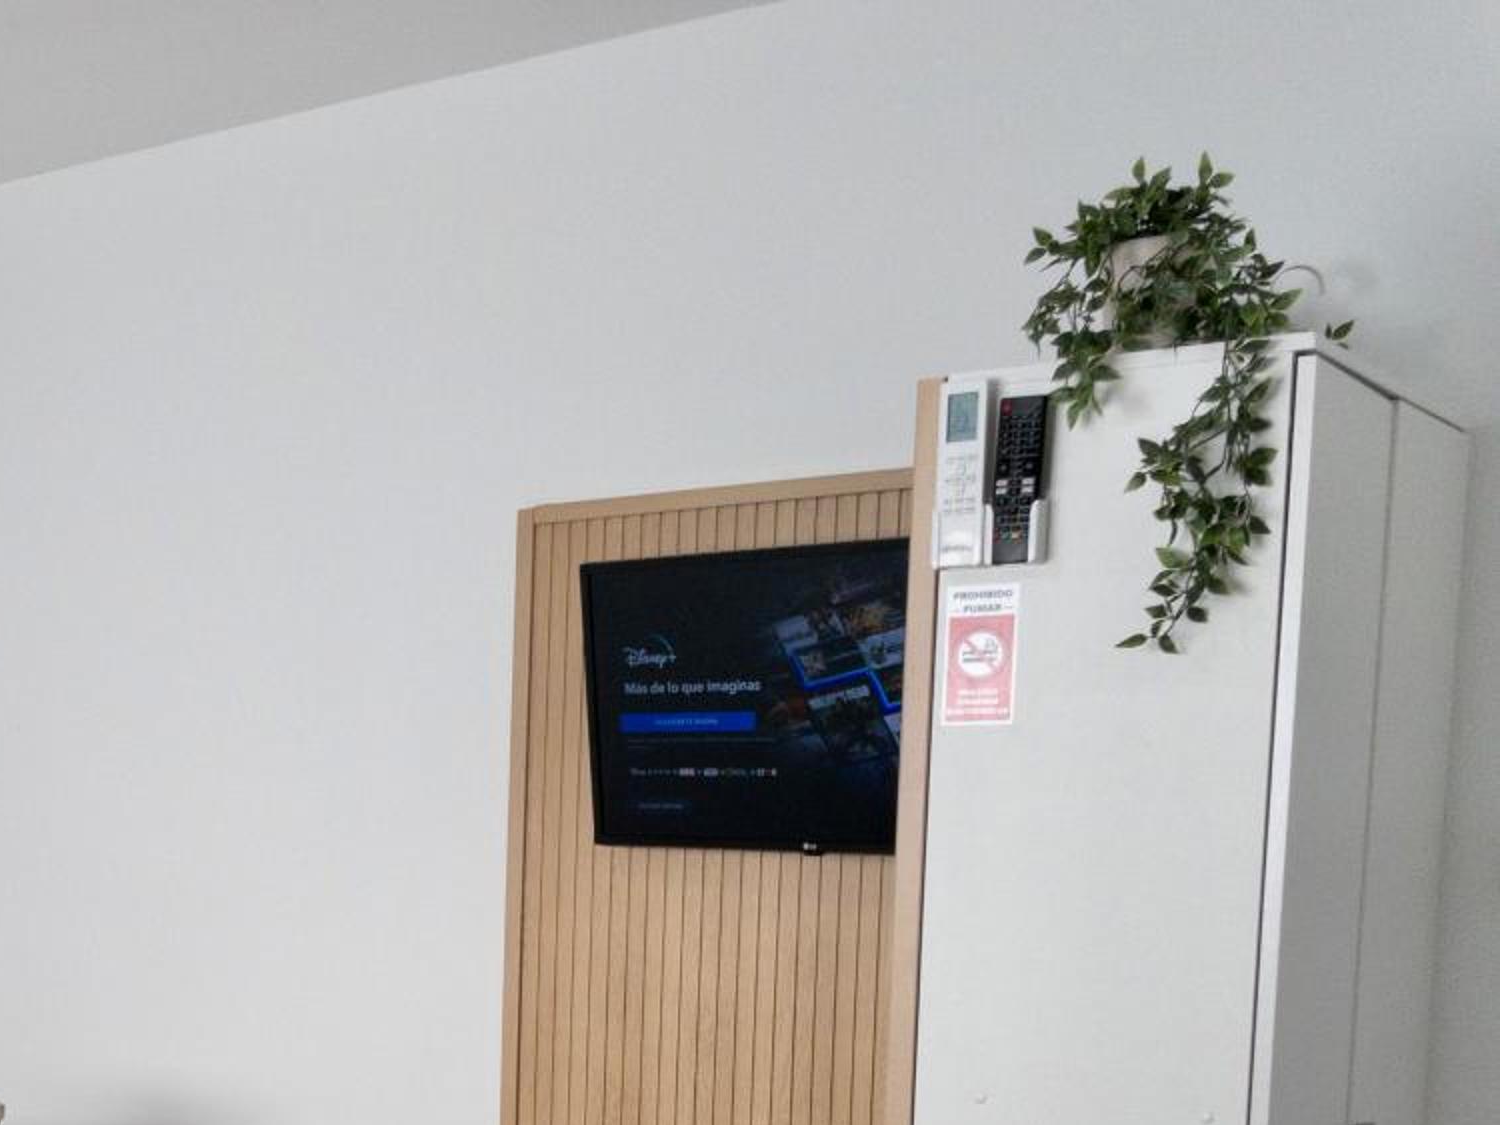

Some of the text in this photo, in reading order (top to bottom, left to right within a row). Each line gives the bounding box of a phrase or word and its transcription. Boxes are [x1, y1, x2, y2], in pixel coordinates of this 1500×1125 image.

[953, 589, 1013, 601] PROHIBIDO
[963, 603, 1002, 614] FUMAR
[624, 680, 761, 696] Más de lo que imaginas
